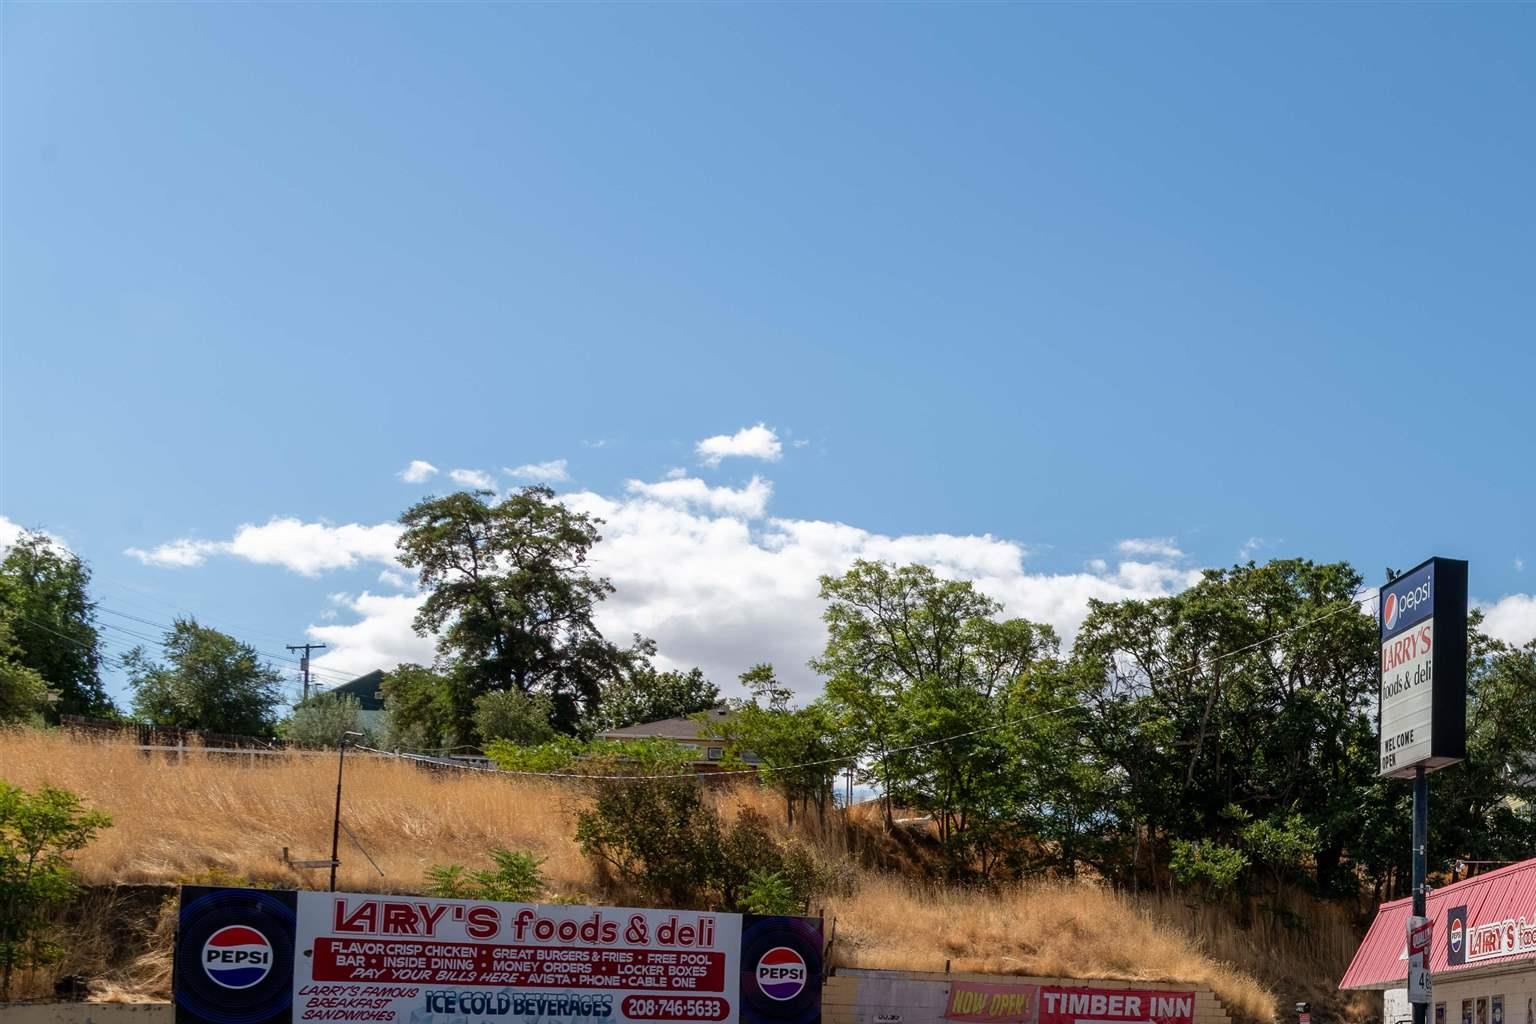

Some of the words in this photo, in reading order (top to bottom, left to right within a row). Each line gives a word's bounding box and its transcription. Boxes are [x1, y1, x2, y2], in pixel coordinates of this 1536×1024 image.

[1399, 576, 1431, 618] pepsi
[1382, 625, 1432, 673] LARRY'S
[1382, 672, 1403, 701] foods
[1404, 673, 1412, 690] &
[1413, 659, 1432, 685] deli
[334, 898, 501, 940] LARRY'S
[511, 907, 621, 945] foods
[623, 912, 651, 946] &
[655, 914, 716, 948] deli
[1469, 920, 1515, 957] LARRY'S
[207, 950, 268, 964] PEPSI
[331, 942, 384, 955] FLAVOR
[386, 943, 422, 956] CRISP
[425, 945, 477, 957] CHICKEN
[492, 948, 533, 960] GREAT
[536, 950, 589, 961] BURGERS
[592, 951, 600, 961] &
[602, 952, 633, 963] FRIES
[647, 953, 677, 964] FREE
[680, 954, 712, 965] POOL
[336, 956, 365, 966] BAR
[384, 957, 426, 968] INSIDE
[431, 959, 474, 970] DINING
[493, 961, 540, 972] MONEY
[543, 962, 592, 973] ORDERS
[618, 964, 664, 975] LOCKER
[668, 965, 707, 976] BOXES
[350, 967, 386, 978] PAY
[391, 969, 432, 980] YOUR
[436, 971, 477, 982] BILLS
[480, 973, 519, 984] HERE
[527, 973, 571, 984] AVISTA
[579, 975, 620, 986] PHONE
[628, 976, 667, 987] CABLE
[672, 977, 696, 988] ONE
[760, 967, 804, 980] PEPSI
[298, 985, 361, 997] LARRY'S
[360, 986, 419, 998] FAMOUS
[952, 990, 989, 1014] NOW
[306, 998, 392, 1009] BREAKFAST
[425, 991, 456, 1014] ICE
[459, 991, 509, 1015] COLD
[512, 993, 613, 1017] BEVERAGES
[1043, 992, 1141, 1017] TIMBER
[1149, 997, 1193, 1018] INN
[301, 1010, 395, 1021] SANDWICHES
